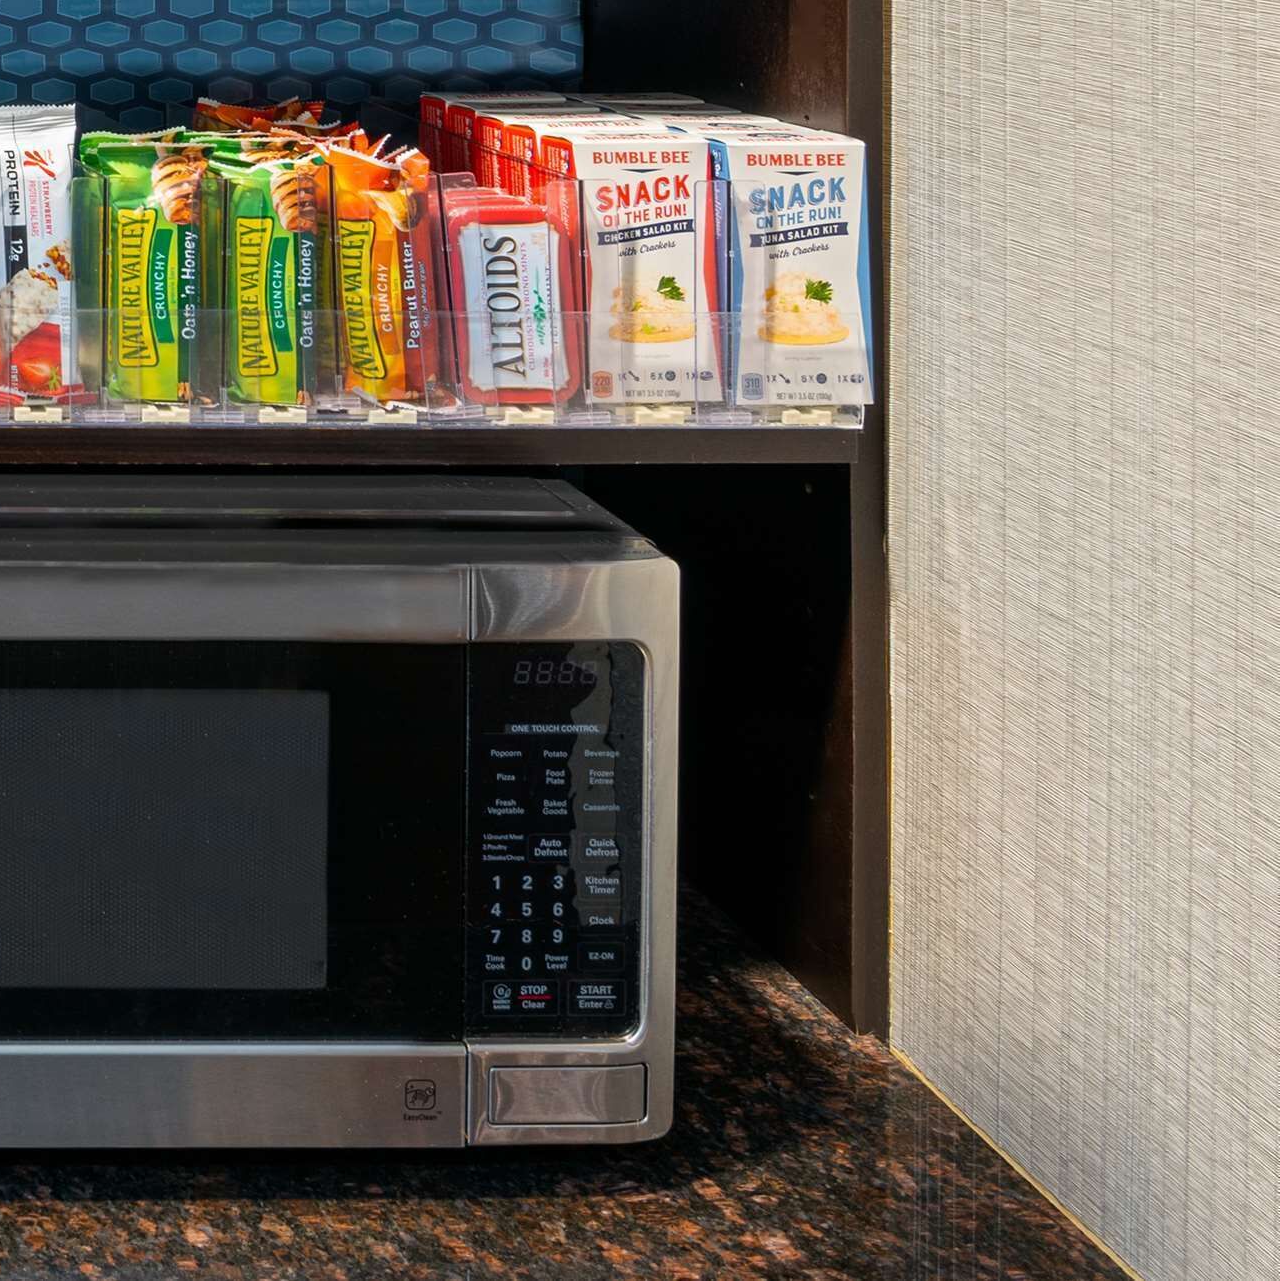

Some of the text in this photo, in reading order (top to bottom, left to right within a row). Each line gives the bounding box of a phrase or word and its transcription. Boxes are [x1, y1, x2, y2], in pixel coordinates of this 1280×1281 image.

[593, 151, 690, 164] BUMBLE BEE
[747, 153, 845, 167] BUMBLE BEE
[4, 149, 20, 216] PROTEIN
[596, 174, 690, 212] SNACK
[749, 176, 846, 214] SNACK
[757, 206, 841, 229] ON THE RUN!
[761, 224, 838, 243] TUNA SALAD KIT
[182, 231, 199, 279] Honey
[120, 213, 155, 361] NATURE VALLEY
[156, 251, 165, 320] CRUNCHY
[483, 236, 527, 380] ALTOIDS
[181, 298, 196, 340] Oats
[512, 724, 599, 733] ONE TOUCH CONTROL
[491, 750, 522, 758] Popcorn
[544, 750, 567, 758] Potato
[493, 876, 563, 889] 1 2 3
[491, 903, 563, 916] 4 5 6
[491, 929, 563, 943] 7 8 9
[521, 957, 531, 971] 0
[520, 986, 547, 994] STOP
[580, 986, 612, 994] START
